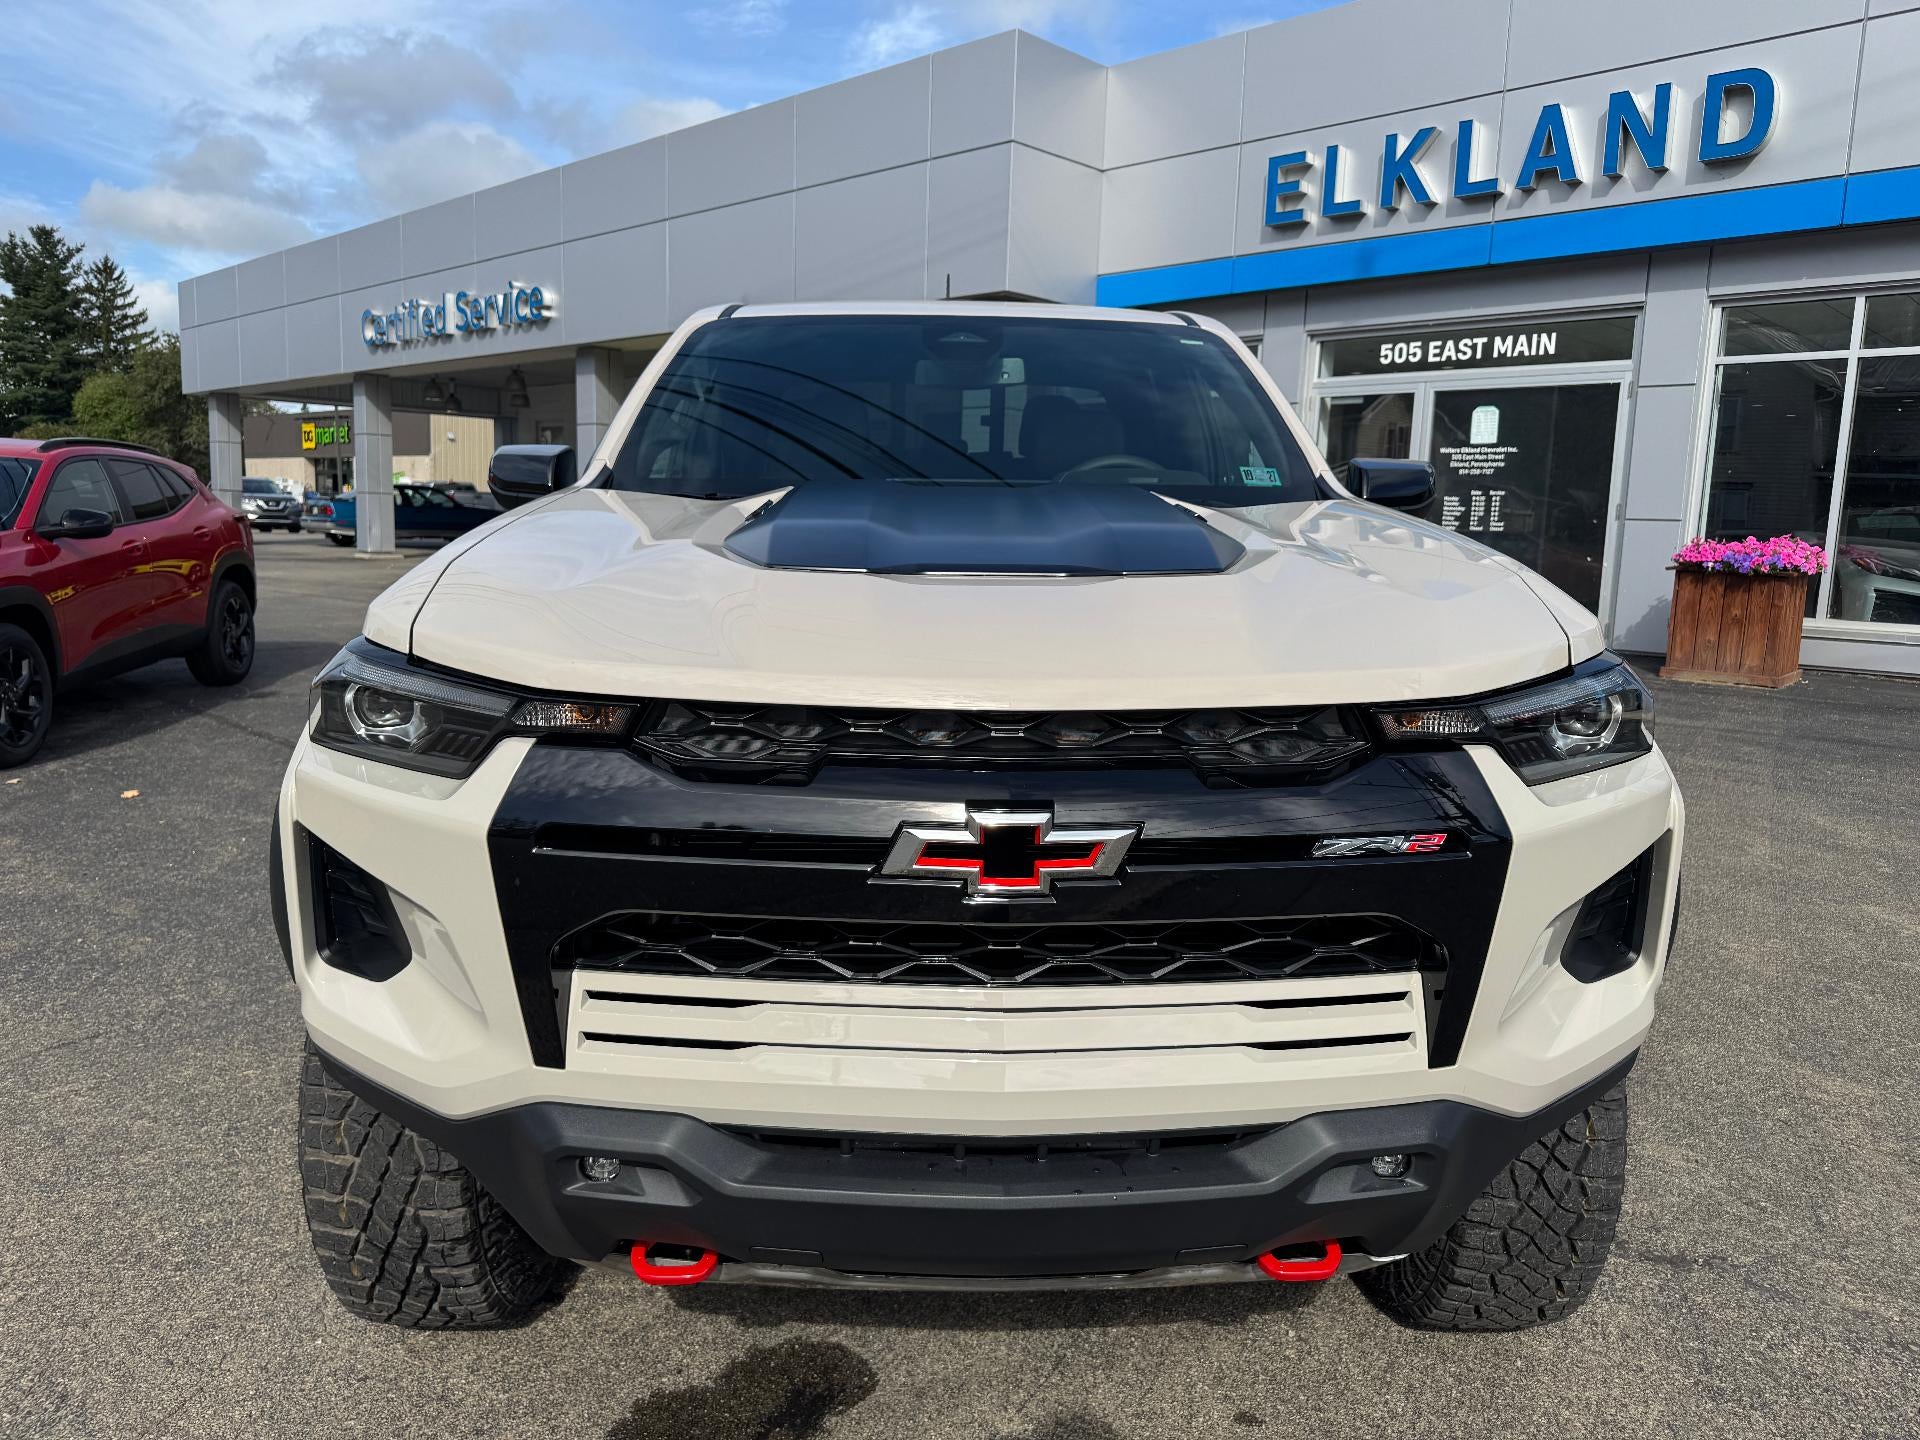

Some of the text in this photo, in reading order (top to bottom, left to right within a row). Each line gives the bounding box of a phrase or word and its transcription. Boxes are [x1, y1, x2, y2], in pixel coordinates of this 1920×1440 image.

[1265, 66, 1778, 228] ELKLAND
[361, 281, 549, 346] Certified Service
[1379, 332, 1557, 365] 505 EAST MAIN
[1312, 834, 1447, 857] ZR2
